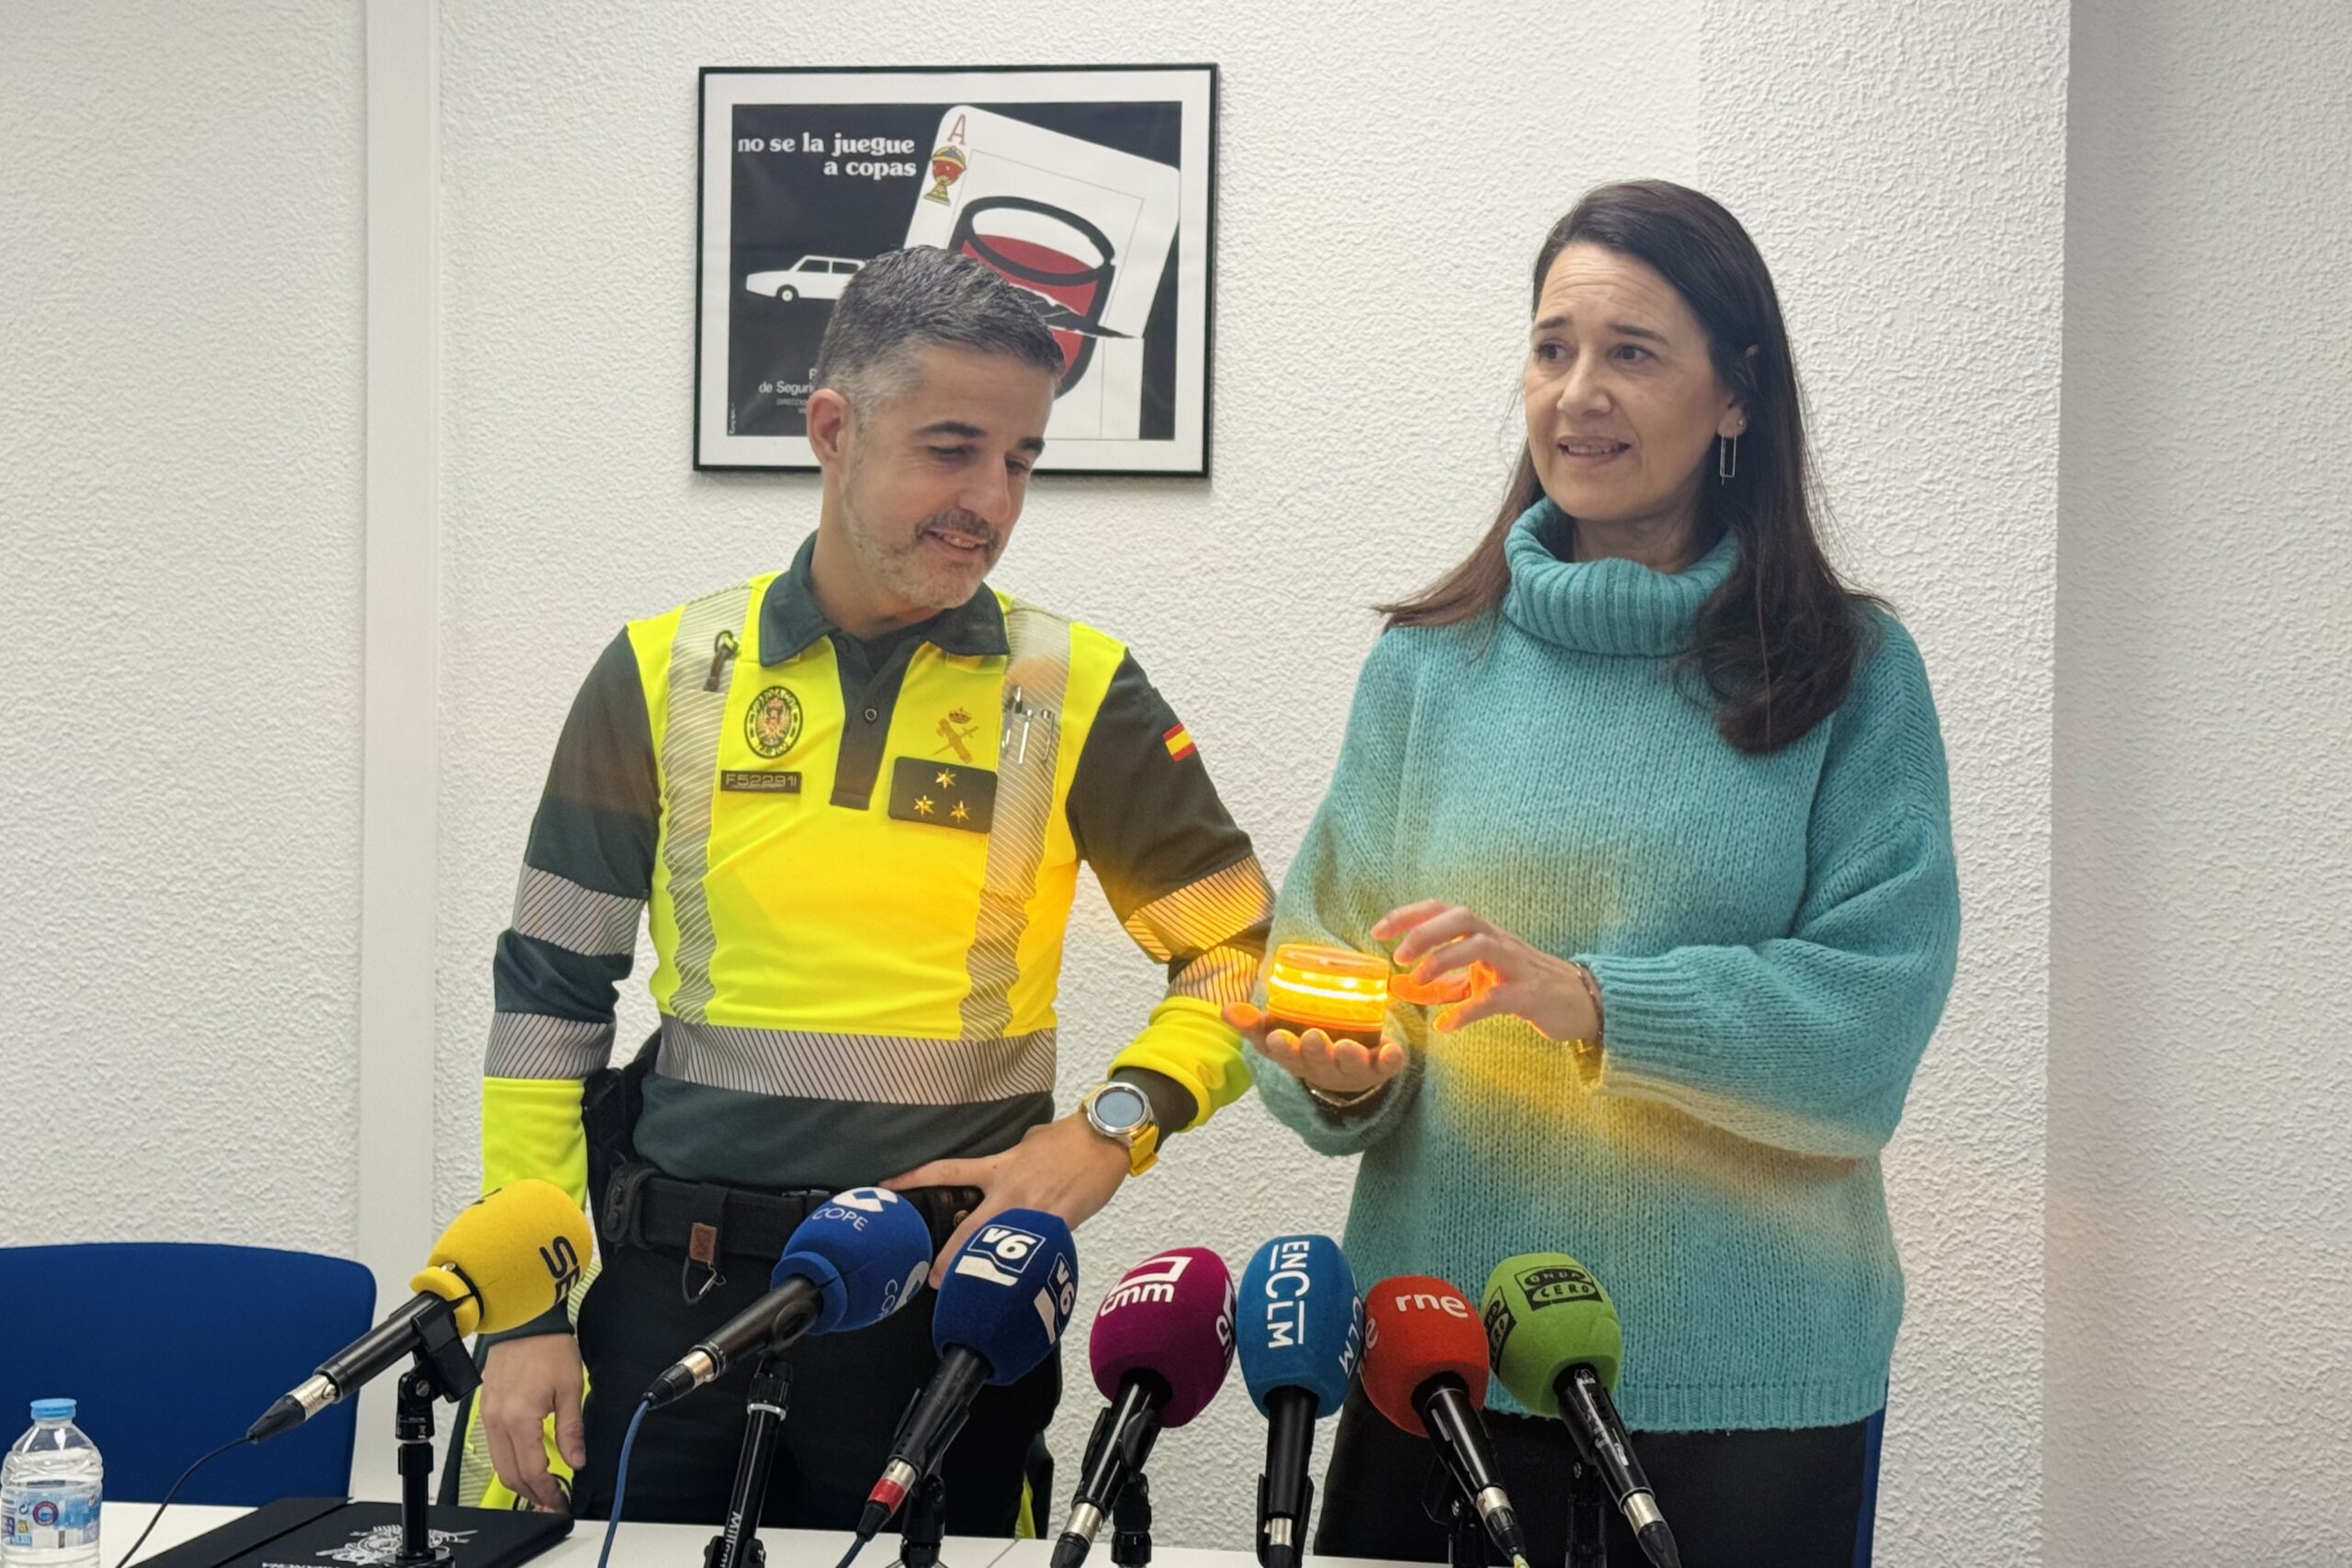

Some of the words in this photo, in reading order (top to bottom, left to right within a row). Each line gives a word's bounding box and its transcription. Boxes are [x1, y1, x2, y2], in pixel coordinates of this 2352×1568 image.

[946, 113, 967, 146] A
[737, 138, 764, 152] no
[769, 138, 795, 152] se
[802, 132, 824, 152] la
[831, 132, 914, 157] juegue
[823, 161, 838, 175] a
[845, 161, 917, 181] copas
[758, 380, 773, 393] de
[776, 380, 814, 396] Seguri
[812, 1207, 868, 1232] COPE
[1530, 1271, 1581, 1282] ONDA
[1100, 1283, 1175, 1317] cmm
[1540, 1283, 1589, 1297] CERO
[1396, 1293, 1469, 1318] rne
